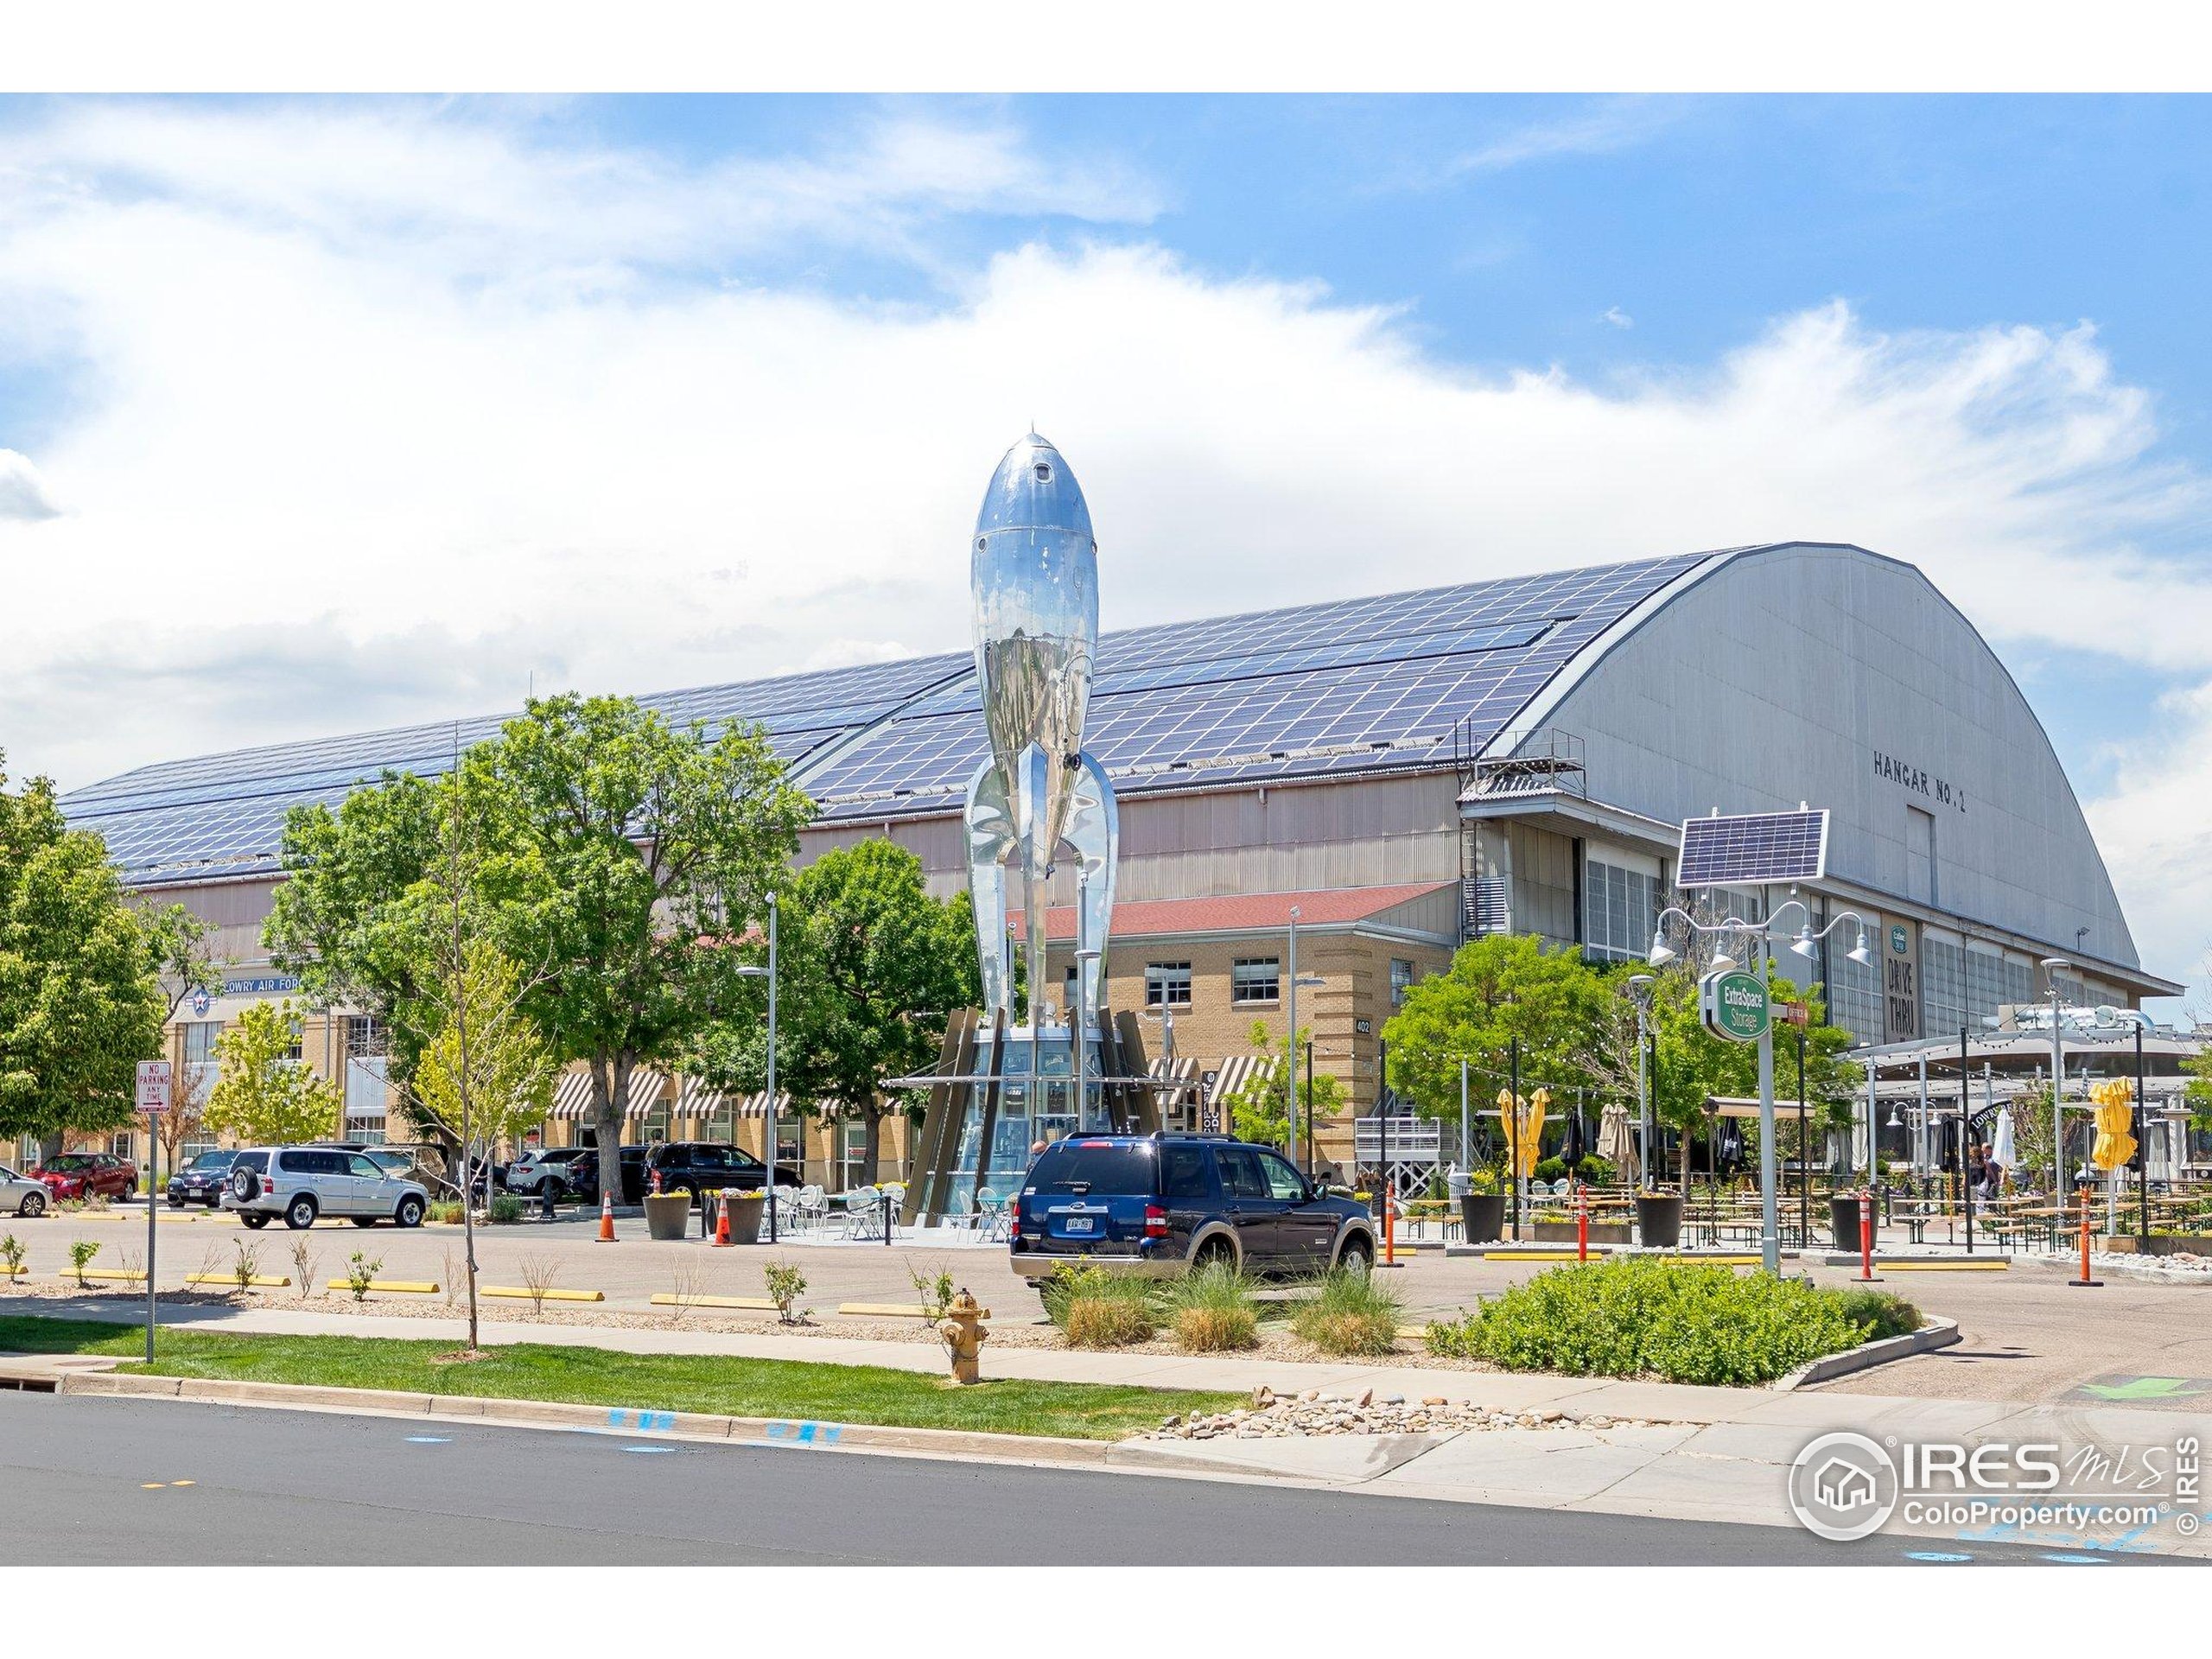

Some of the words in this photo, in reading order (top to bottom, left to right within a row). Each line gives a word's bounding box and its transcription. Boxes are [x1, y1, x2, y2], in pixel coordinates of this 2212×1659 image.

[1873, 751, 1929, 797] HANGAR
[224, 979, 255, 993] LOWRY
[258, 979, 275, 991] AIR
[1888, 957, 1912, 997] DRIVE
[1724, 986, 1763, 1010] ExtraSpace
[1731, 1007, 1758, 1032] Storage
[1889, 996, 1915, 1036] THRU
[139, 1075, 168, 1084] PARKING
[149, 1065, 160, 1074] NO
[1972, 1106, 1998, 1129] LOWR
